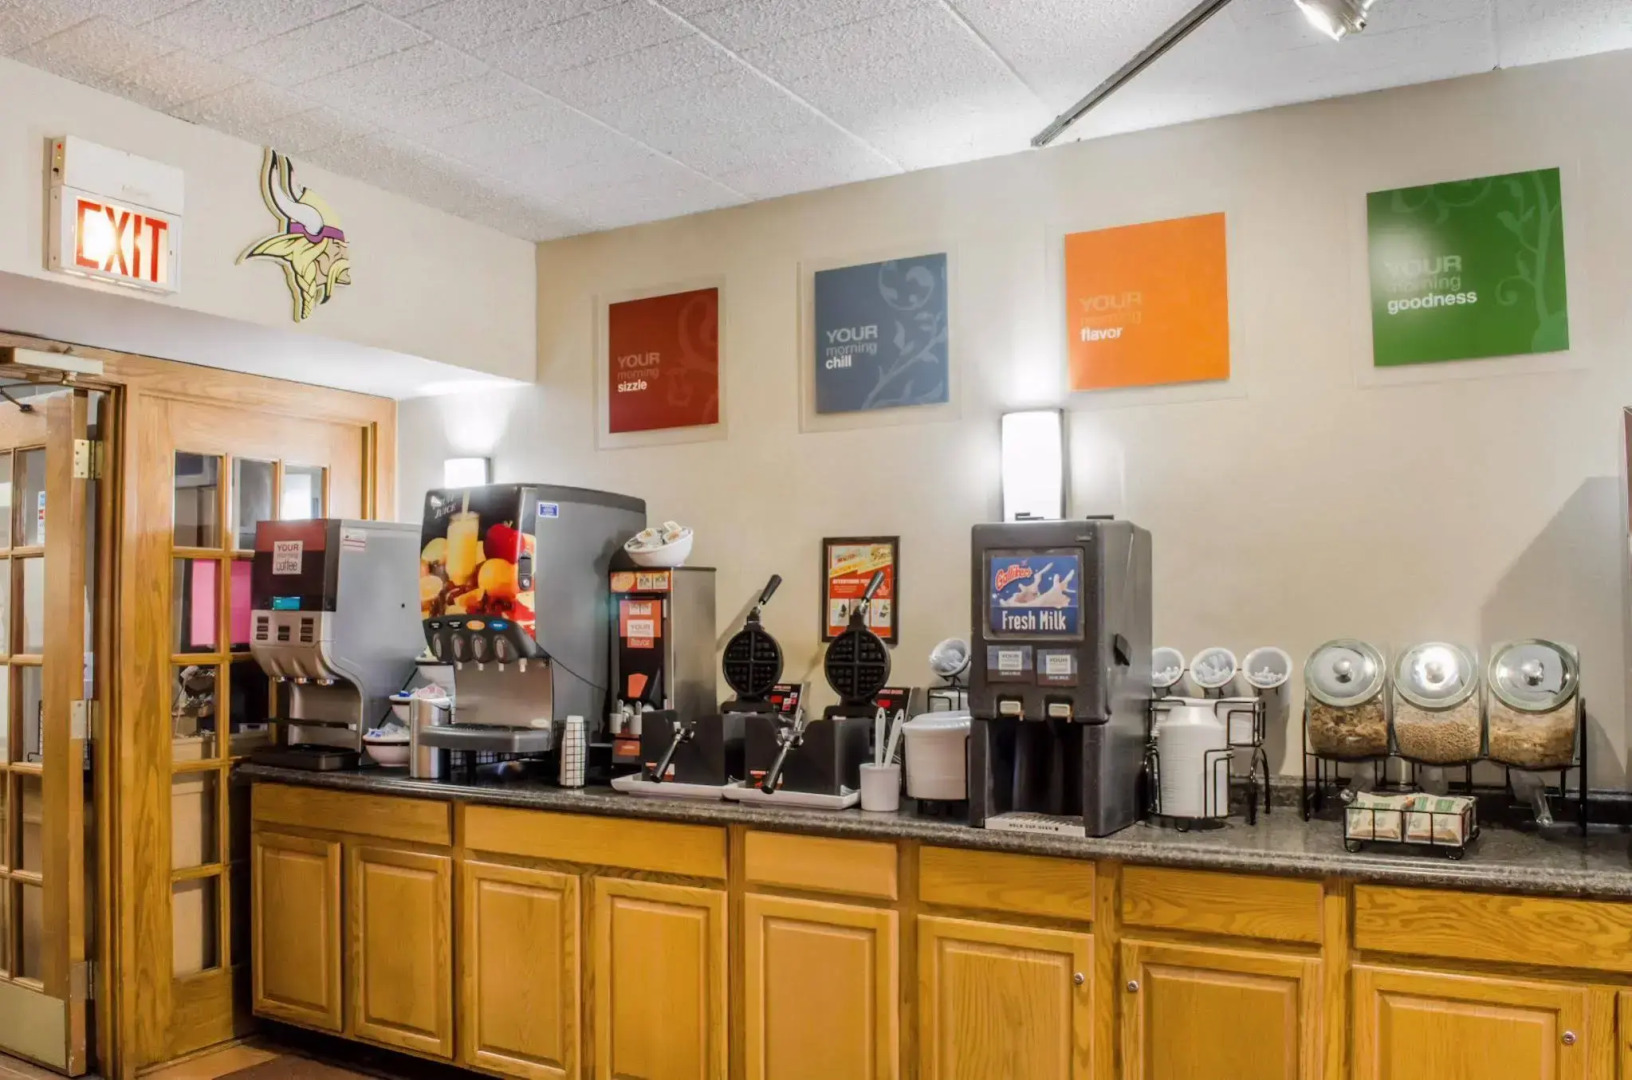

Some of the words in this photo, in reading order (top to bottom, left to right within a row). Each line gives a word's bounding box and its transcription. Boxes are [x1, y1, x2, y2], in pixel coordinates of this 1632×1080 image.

[76, 199, 168, 282] EXIT
[1383, 255, 1462, 277] YOUR
[1079, 291, 1142, 312] YOUR
[1387, 291, 1478, 315] goodness
[825, 325, 878, 344] YOUR
[1081, 326, 1123, 342] flavor
[825, 343, 878, 357] morning
[617, 351, 660, 369] YOUR
[825, 354, 852, 370] chill
[617, 367, 660, 380] morning
[617, 379, 648, 393] sizzle
[434, 502, 457, 519] JUICE
[276, 543, 300, 552] YOUR
[275, 559, 299, 572] coffee
[1002, 610, 1036, 630] Fresh
[1040, 611, 1067, 630] Milk
